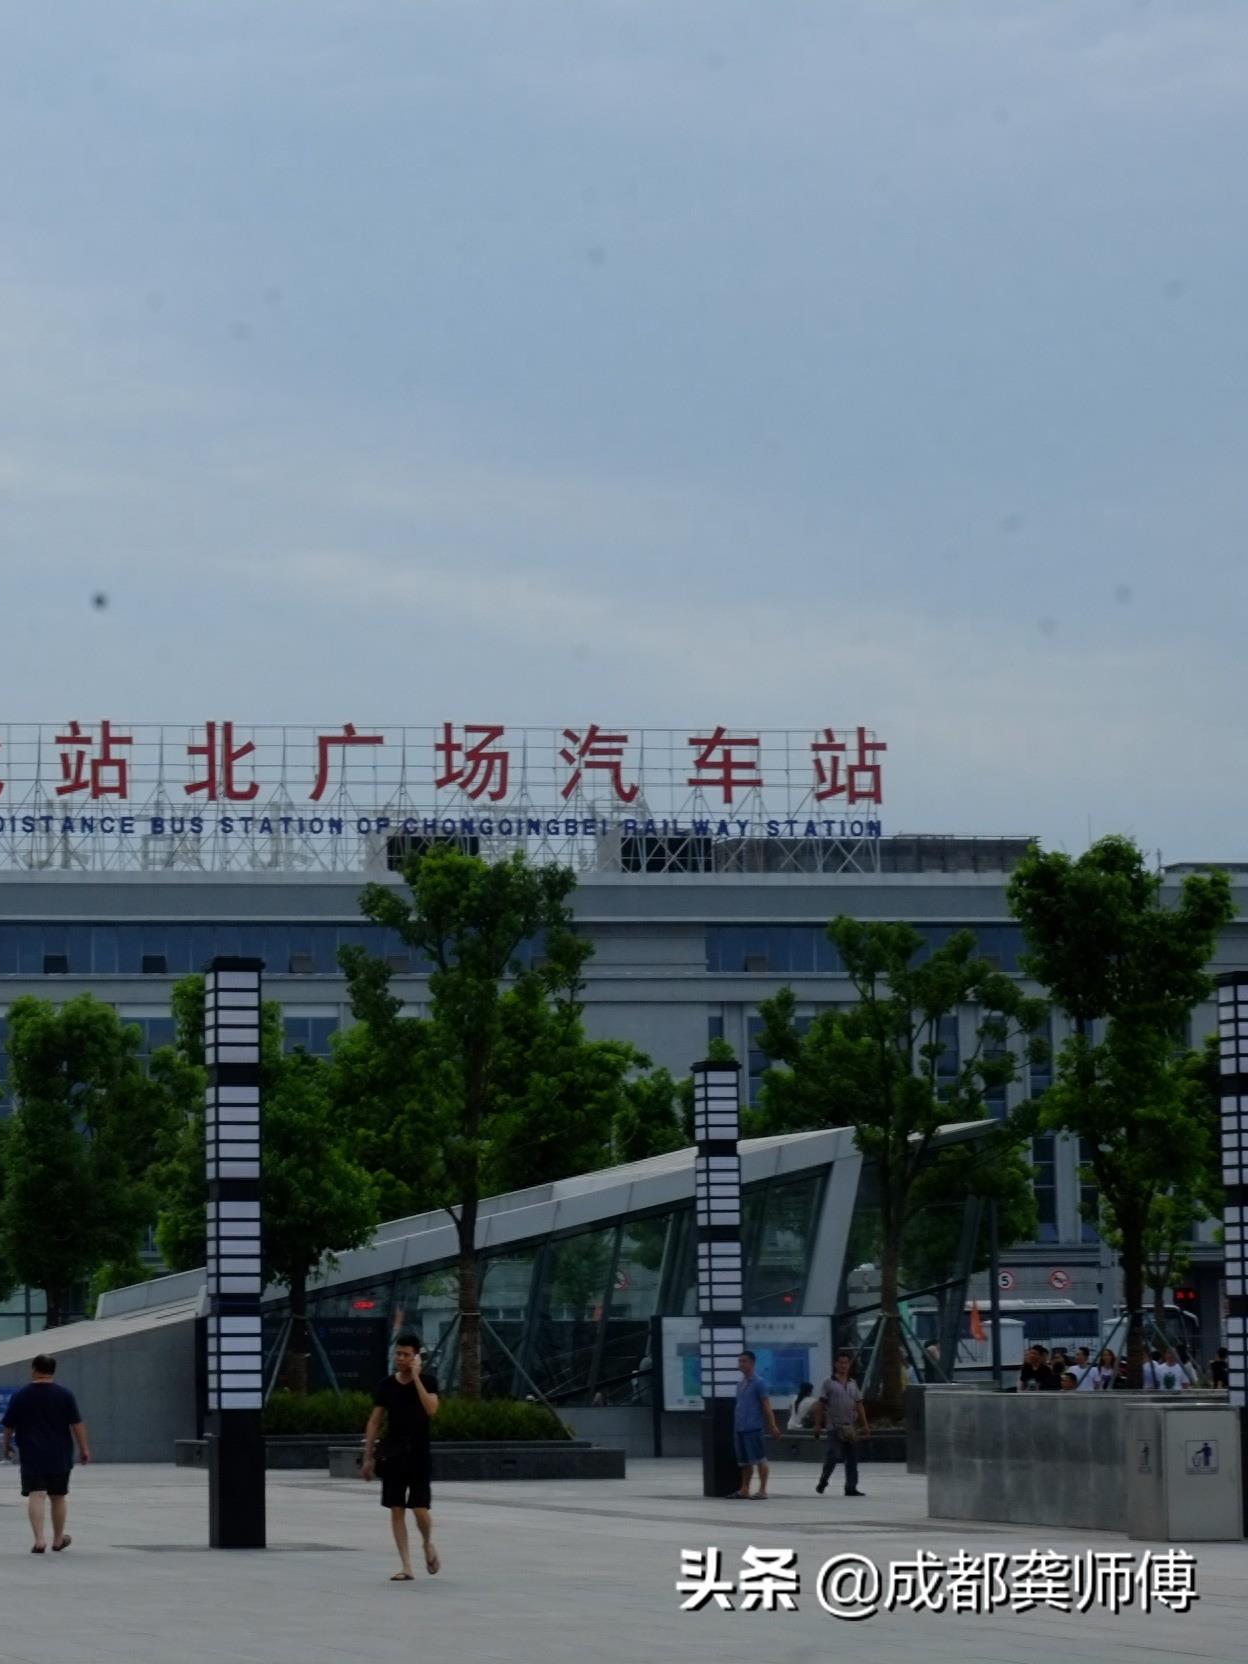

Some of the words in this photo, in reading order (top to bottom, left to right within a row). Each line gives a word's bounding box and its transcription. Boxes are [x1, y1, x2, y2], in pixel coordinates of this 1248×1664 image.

[150, 816, 205, 834] BUS
[219, 816, 344, 835] STATION
[356, 816, 390, 835] OF
[402, 816, 608, 837] CHONGQINGBEI
[623, 818, 750, 837] RAILWAY
[766, 819, 883, 838] STATION
